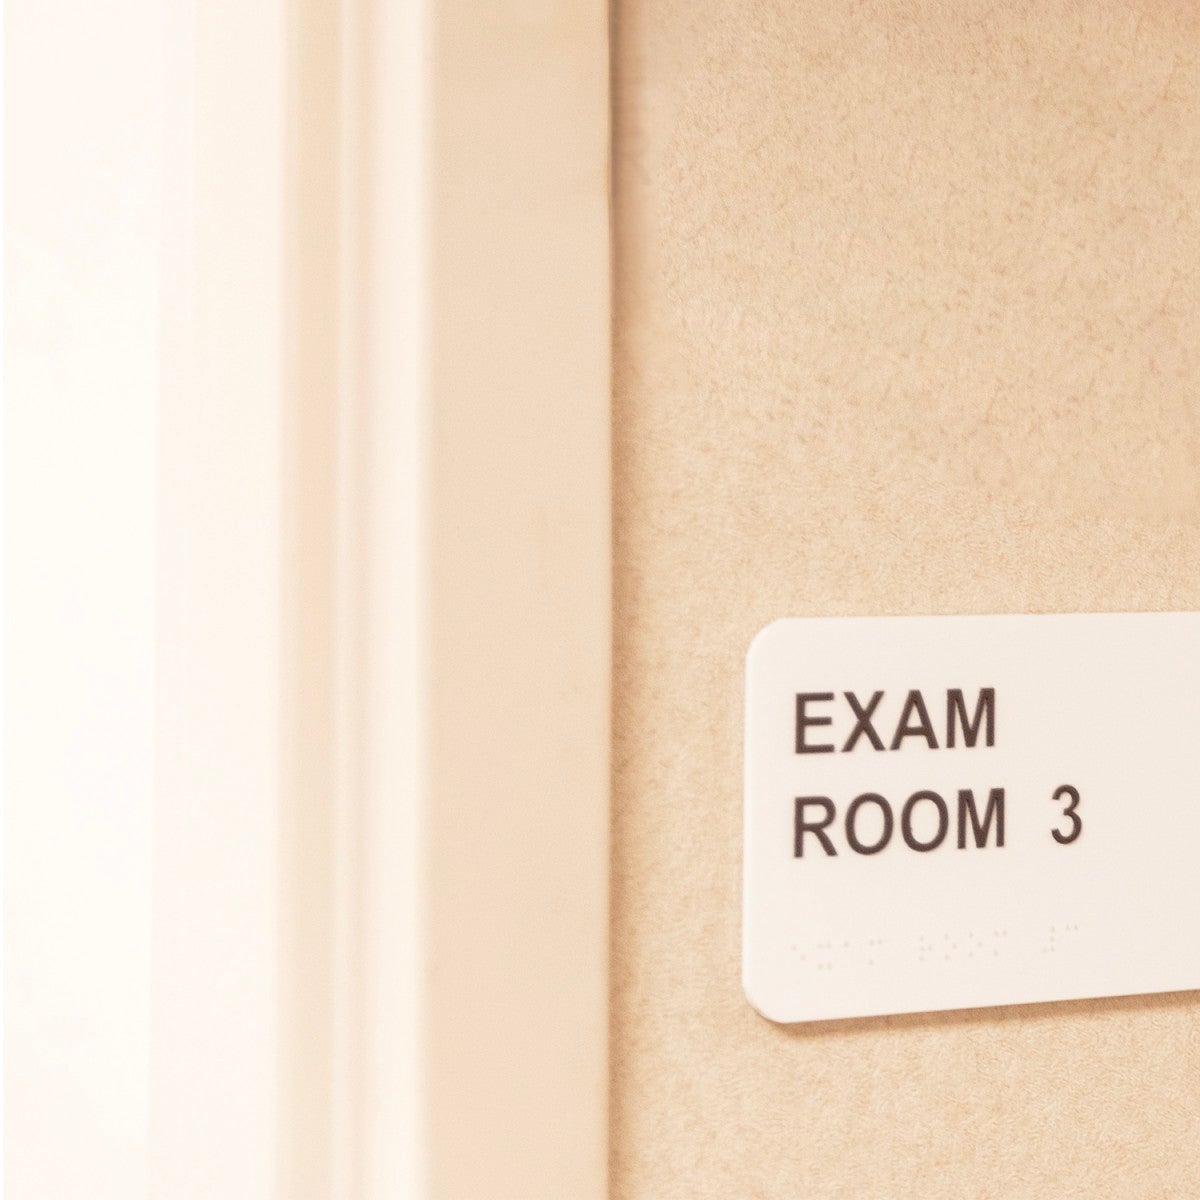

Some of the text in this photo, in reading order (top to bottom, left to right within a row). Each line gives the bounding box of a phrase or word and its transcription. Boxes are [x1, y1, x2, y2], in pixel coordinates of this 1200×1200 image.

[795, 687, 996, 755] EXAM
[793, 784, 1083, 859] ROOM 3
